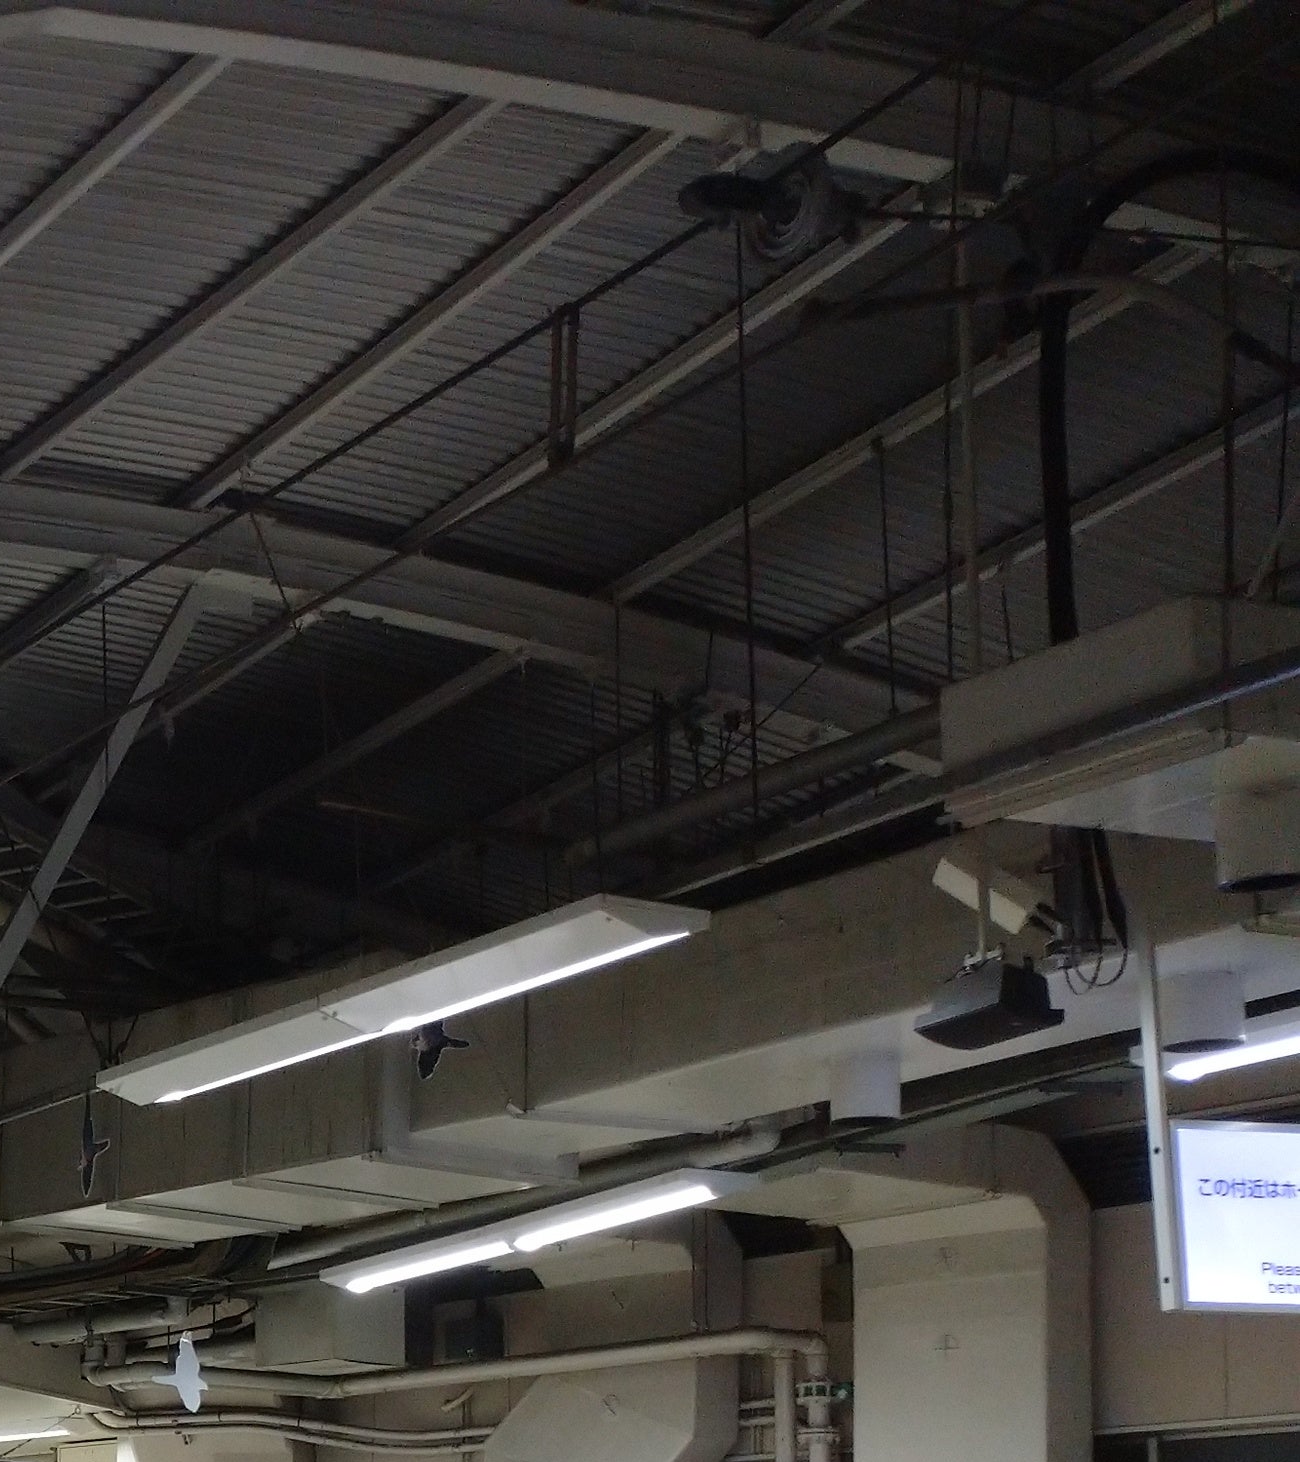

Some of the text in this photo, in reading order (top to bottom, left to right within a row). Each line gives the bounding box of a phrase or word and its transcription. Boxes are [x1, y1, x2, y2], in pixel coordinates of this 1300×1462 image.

[1199, 1178, 1300, 1199] この付近はホ
